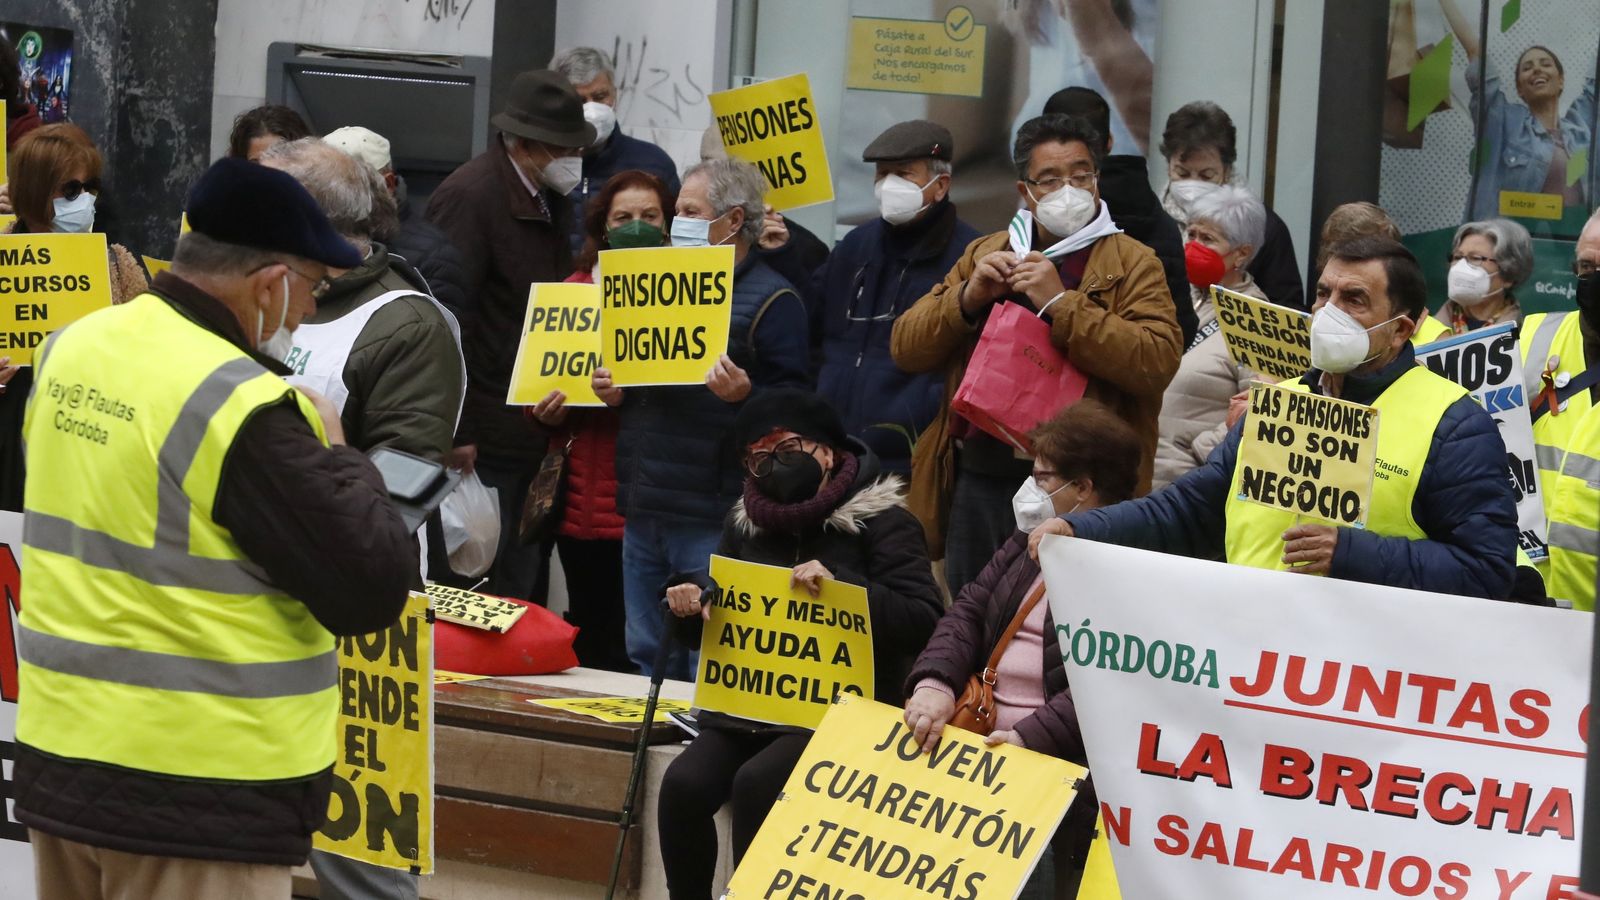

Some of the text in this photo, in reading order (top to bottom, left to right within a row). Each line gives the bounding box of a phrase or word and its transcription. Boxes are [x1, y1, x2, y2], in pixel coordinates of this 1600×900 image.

[874, 43, 901, 56] Caja
[904, 45, 931, 55] Rural
[934, 47, 952, 57] del
[876, 28, 926, 41] Pásate a
[872, 71, 922, 83] de todo!
[901, 61, 967, 74] encargamos
[717, 97, 813, 147] PENSIONES
[752, 152, 807, 190] NAS
[1510, 199, 1536, 208] Entrar
[0, 244, 51, 266] MÁS
[603, 271, 727, 308] PENSIONES
[15, 303, 48, 321] EN
[1215, 292, 1309, 333] ESTA ES LA
[615, 326, 706, 362] DIGNAS
[1226, 332, 1312, 368] DEFENDÁMO
[1231, 347, 1252, 367] LA
[1427, 336, 1516, 391] MOS
[46, 377, 136, 422] Yay@ Flautas
[1252, 387, 1371, 439] LAS PENSIONES
[55, 410, 109, 445] Córdoba
[1257, 420, 1360, 463] NO SON
[1288, 452, 1323, 479] UN
[1243, 466, 1361, 522] NEGOCIO
[710, 585, 868, 635] MÁS Y MEJOR
[719, 622, 853, 668] AYUDA A
[338, 667, 419, 731] ENDE
[1055, 618, 1220, 689] CÓRDOBA
[1229, 650, 1552, 740] JUNTAS
[345, 724, 386, 772] EL
[874, 721, 1007, 795] JOVEN,
[1135, 722, 1575, 841] LA BRECHA
[804, 760, 1036, 860] CUARENTÓN
[785, 819, 987, 900] ¿TENDRÁS
[1154, 814, 1471, 900] SALARIOS
[1494, 868, 1533, 900] Y
